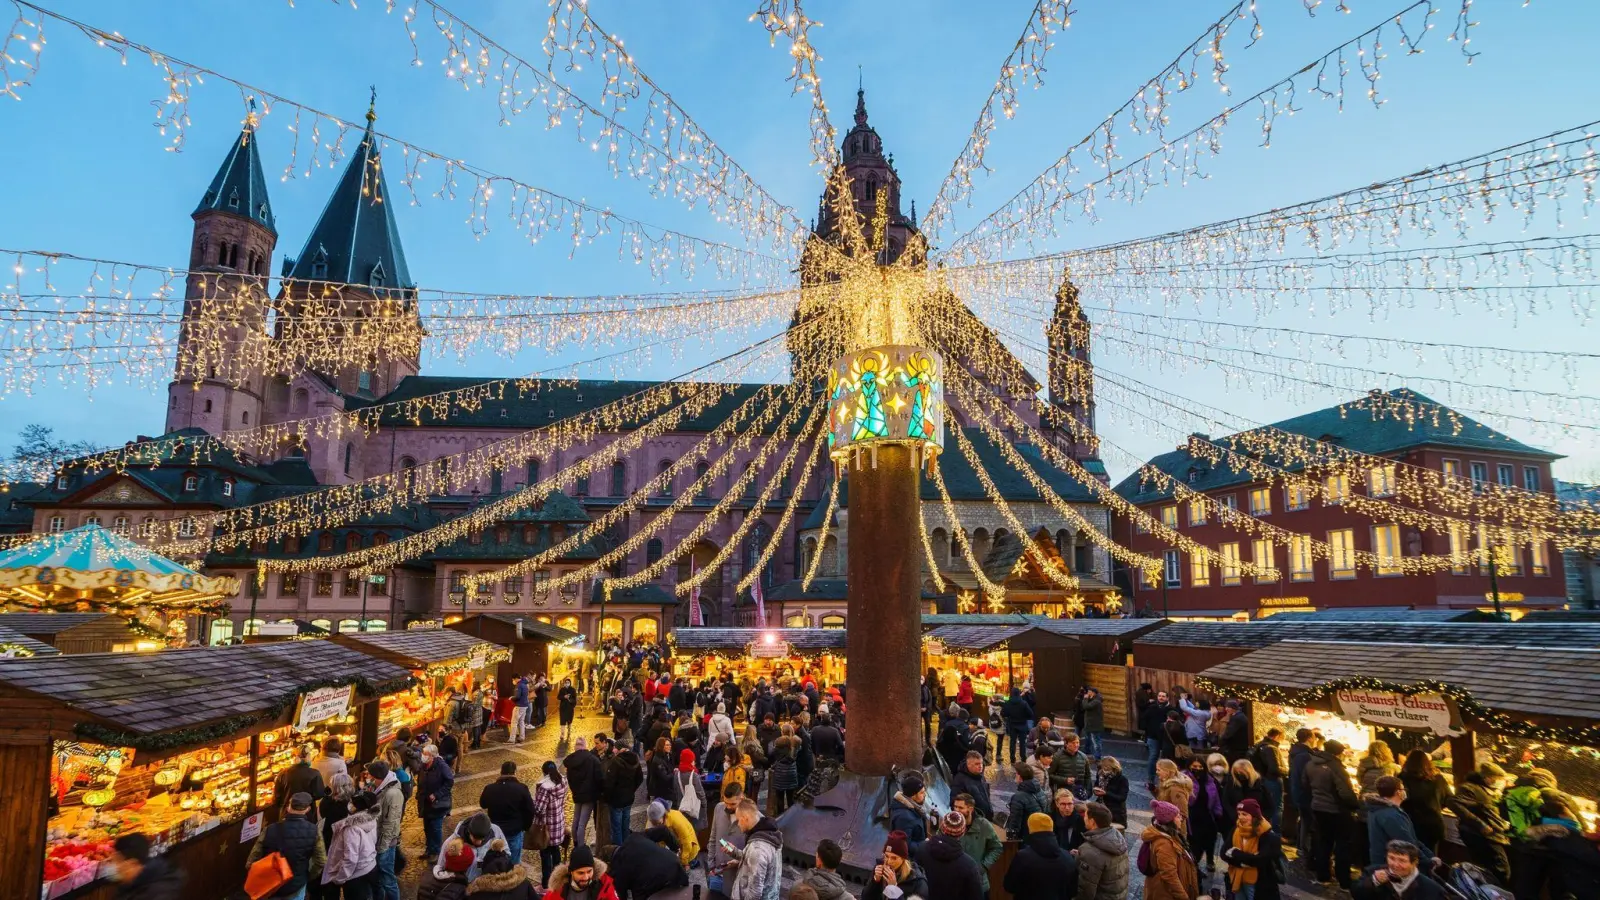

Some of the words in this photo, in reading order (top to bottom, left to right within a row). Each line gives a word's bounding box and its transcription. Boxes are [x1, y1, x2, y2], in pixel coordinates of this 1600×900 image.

[1338, 690, 1399, 706] Glaskunst
[1401, 695, 1447, 711] Glazer
[1359, 704, 1392, 717] Semen
[1394, 708, 1429, 722] Glazer
